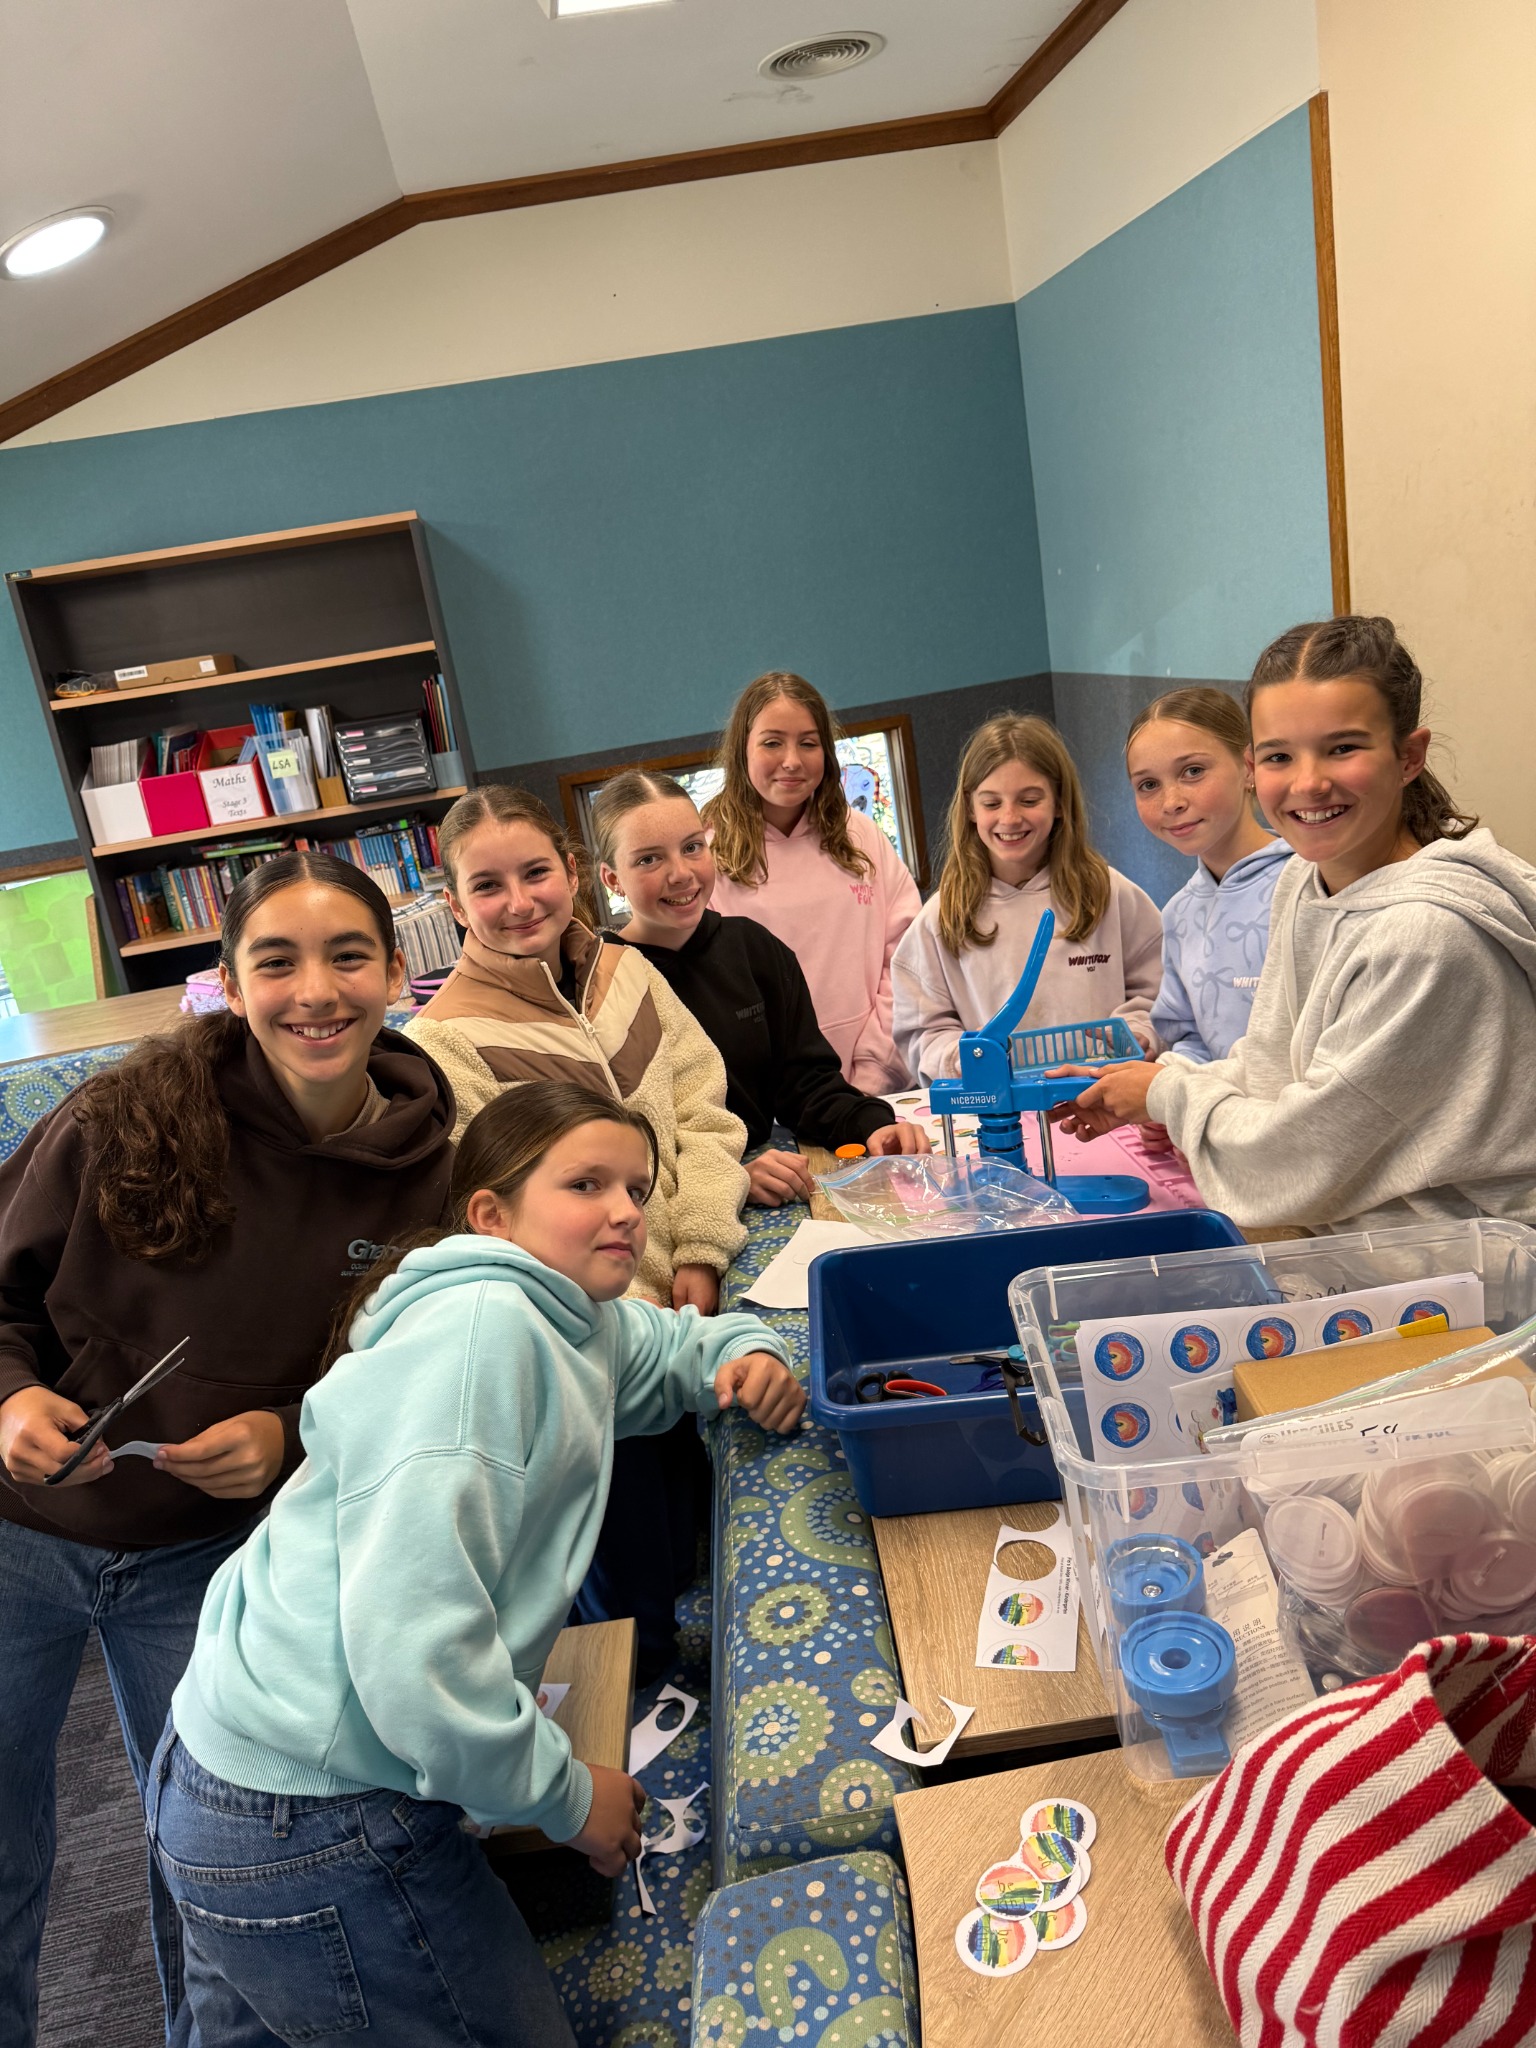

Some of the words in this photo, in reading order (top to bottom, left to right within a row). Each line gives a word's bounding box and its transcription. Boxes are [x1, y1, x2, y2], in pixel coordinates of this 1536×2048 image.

[272, 758, 291, 770] LSA
[212, 773, 247, 788] Maths
[222, 799, 241, 808] Stage
[228, 809, 247, 817] Texts
[1233, 1618, 1262, 1638] 用说明
[1235, 1625, 1266, 1642] RECTIONS
[997, 1880, 1014, 1893] be
